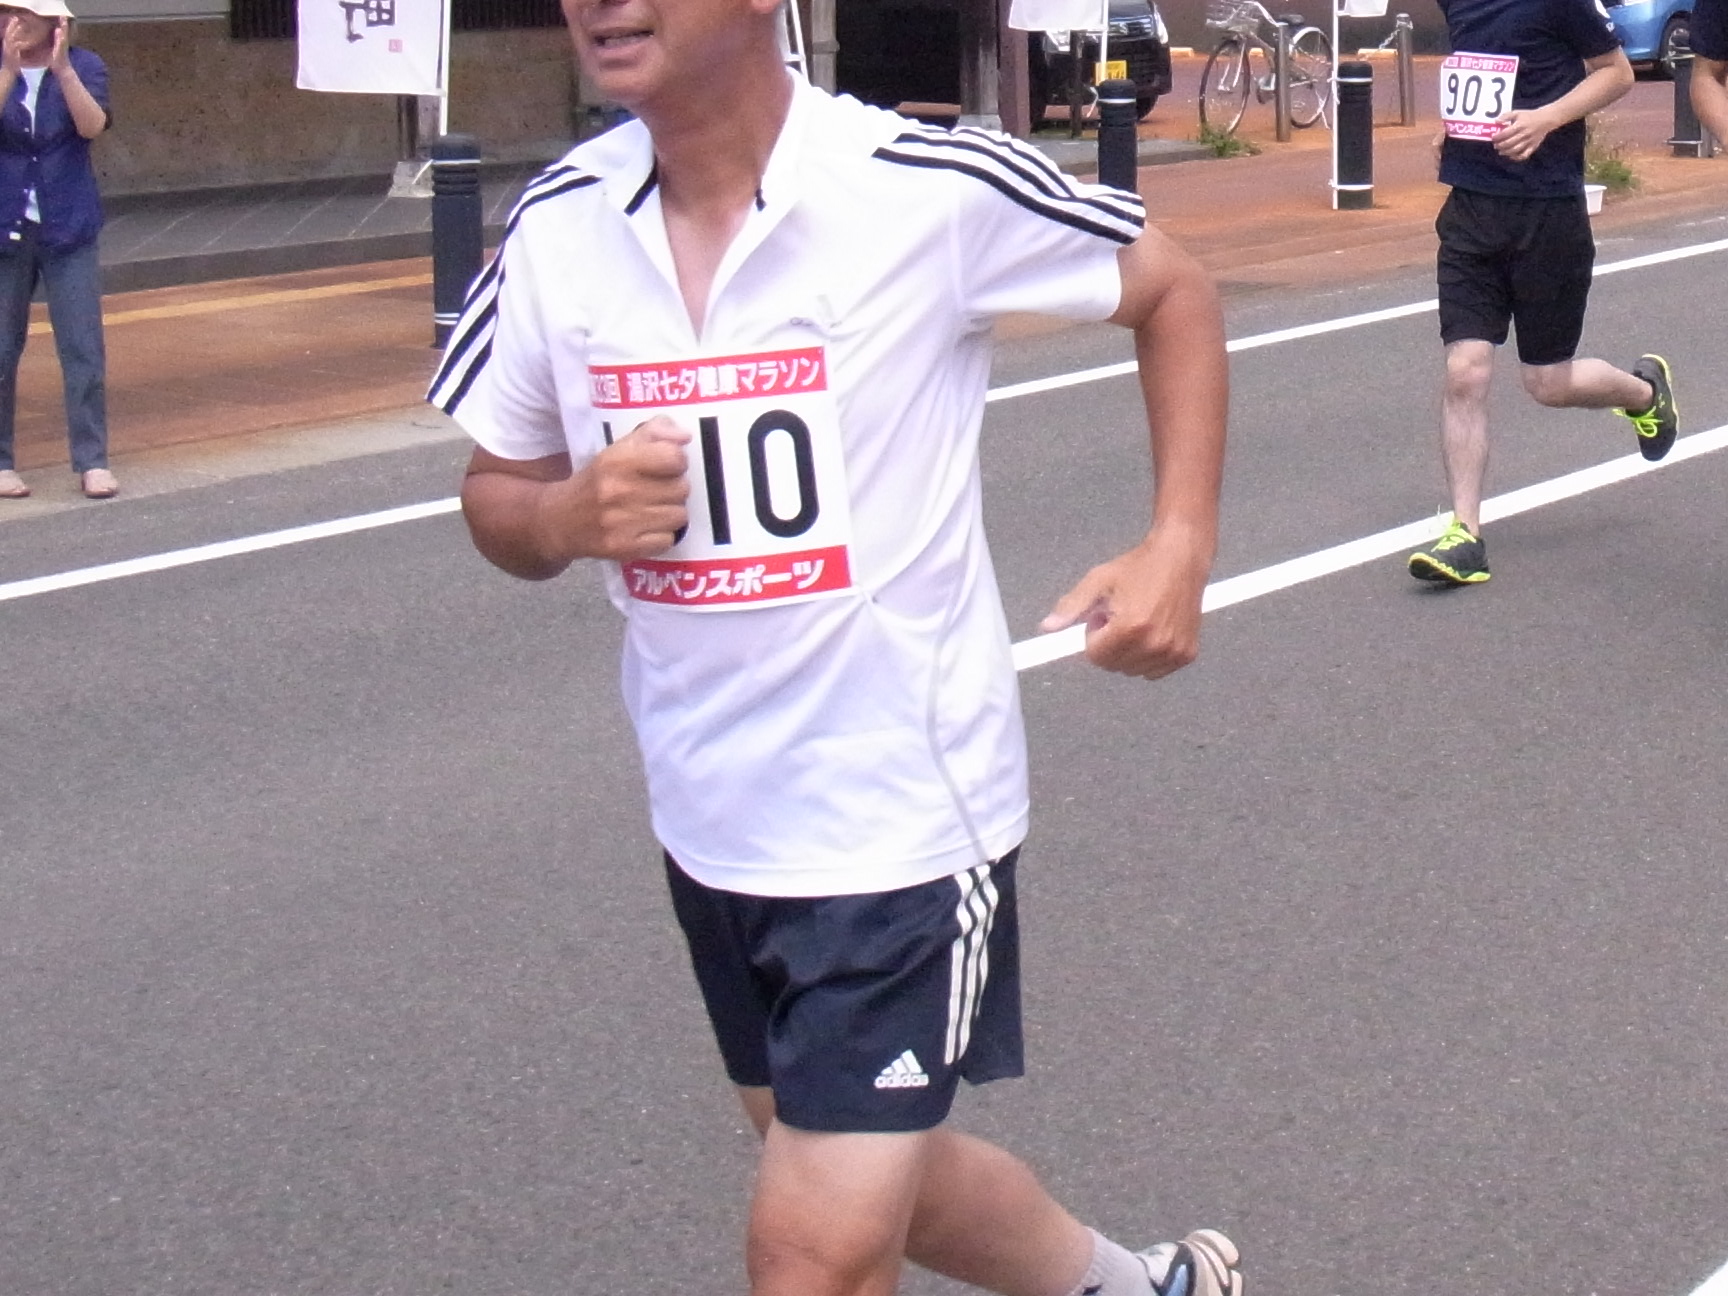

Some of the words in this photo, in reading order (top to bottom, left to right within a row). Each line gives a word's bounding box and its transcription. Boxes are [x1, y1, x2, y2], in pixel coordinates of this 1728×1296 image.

[1446, 72, 1506, 119] 903
[602, 409, 820, 546] 10
[631, 559, 825, 597] アルペンスポーツ
